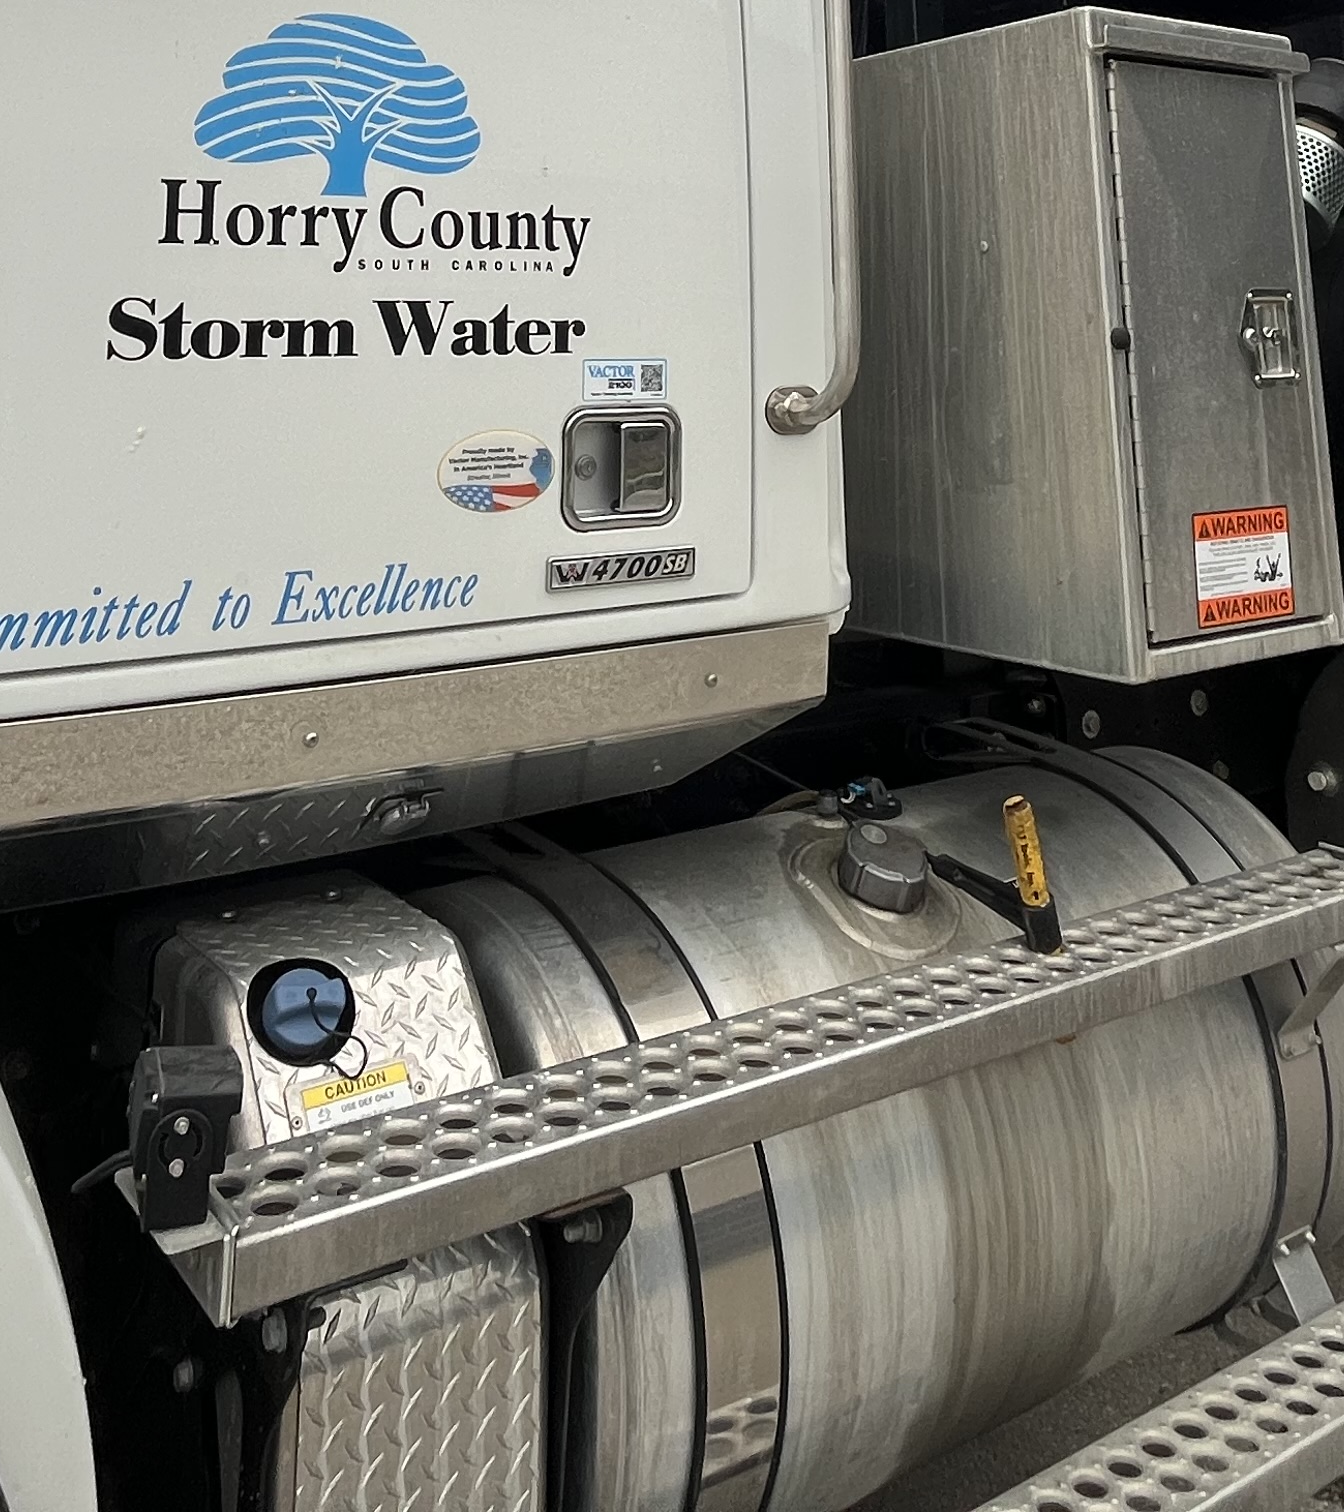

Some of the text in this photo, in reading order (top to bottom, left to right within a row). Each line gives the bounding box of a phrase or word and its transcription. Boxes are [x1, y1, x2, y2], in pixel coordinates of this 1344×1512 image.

[157, 178, 591, 277] Horry County
[357, 258, 554, 272] SOUTH CAROLINA
[106, 297, 585, 361] Storm Water
[587, 365, 635, 377] VACTOR
[1211, 511, 1285, 537] WARNING
[211, 585, 250, 631] to
[270, 563, 479, 625] Excellence
[1216, 591, 1290, 620] WARNING
[324, 1070, 387, 1100] CAUTION
[375, 1090, 395, 1103] ONLY
